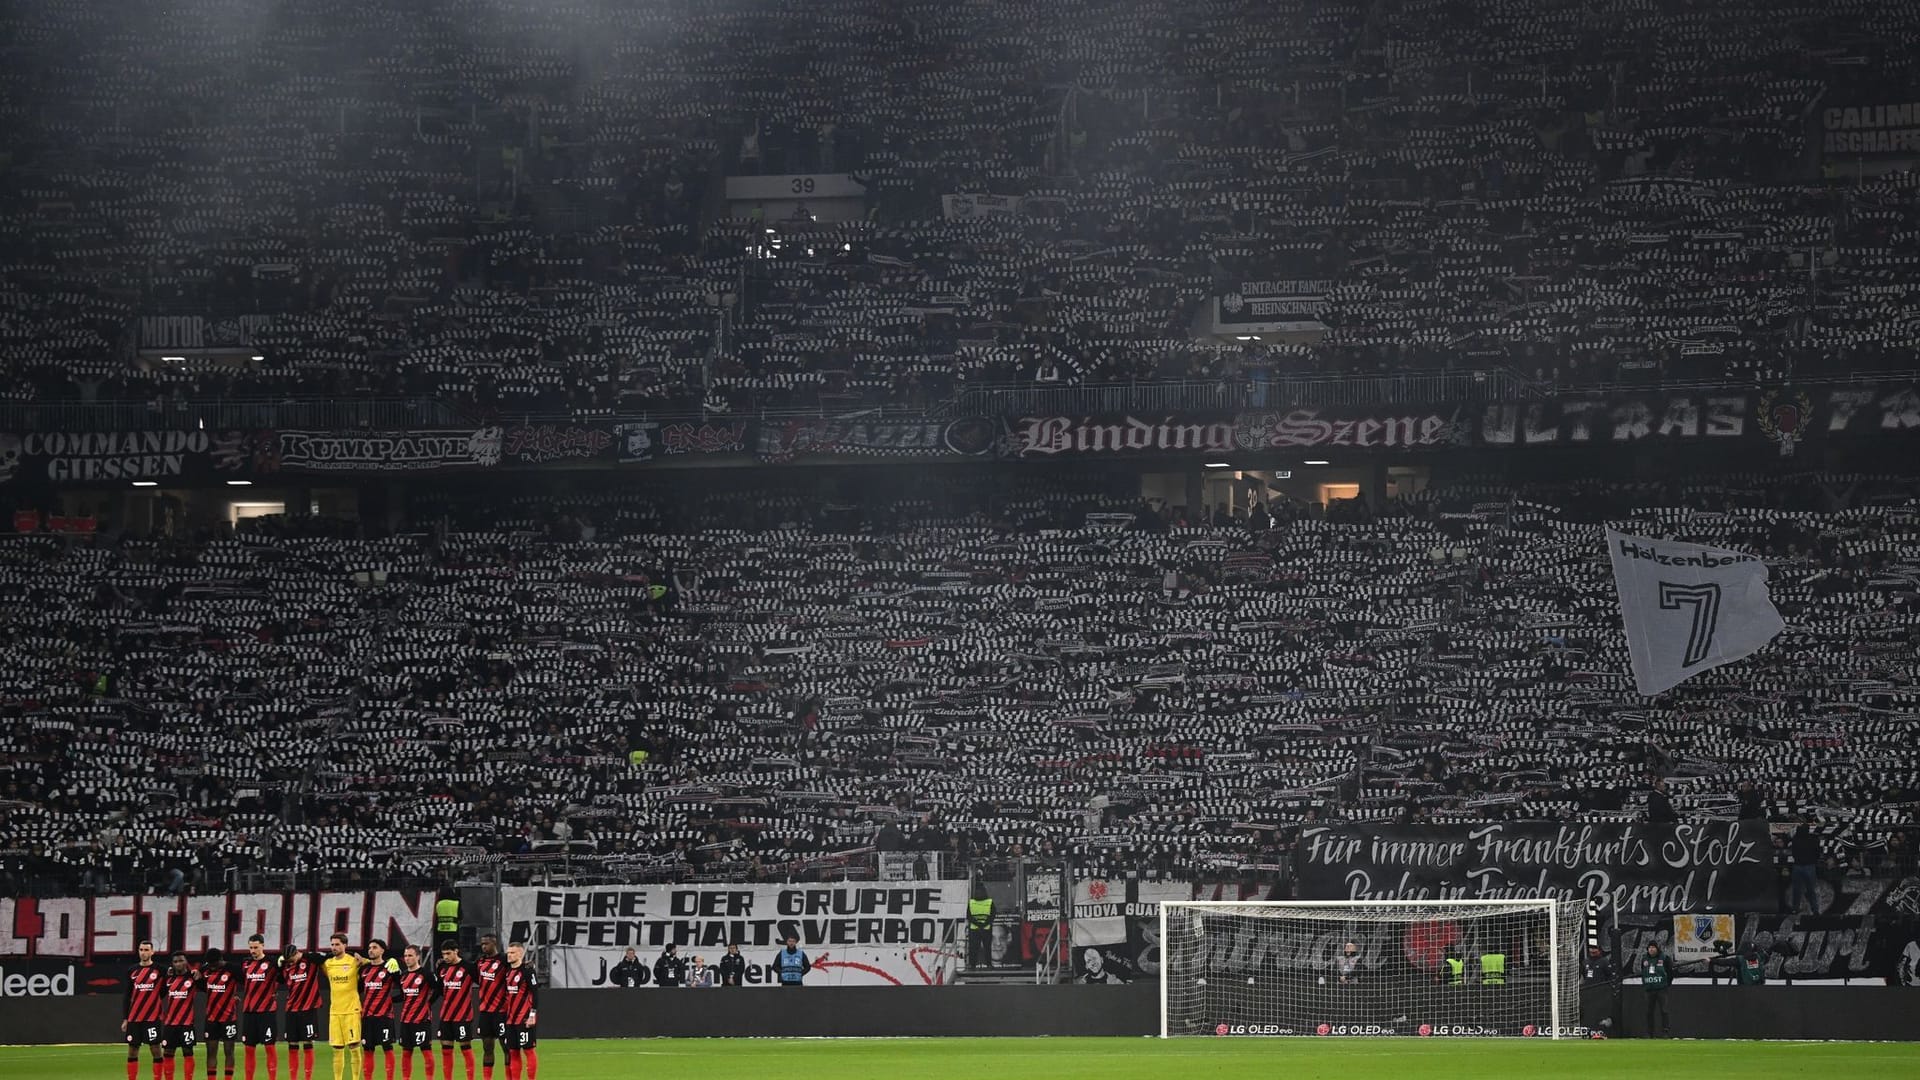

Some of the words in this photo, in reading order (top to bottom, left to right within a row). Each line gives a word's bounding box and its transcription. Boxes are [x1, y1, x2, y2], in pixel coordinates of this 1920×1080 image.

[791, 178, 815, 194] 39
[1241, 280, 1297, 296] EINTRACHT
[142, 315, 204, 348] MOTOR
[1482, 398, 1744, 443] ULTRAS
[1019, 415, 1235, 457] Binding
[1271, 409, 1446, 449] Szene
[24, 430, 209, 456] COMMANDO
[279, 434, 473, 461] KUMPANE
[47, 454, 185, 481] GIESSEN
[1659, 581, 1721, 668] 7
[1303, 827, 1361, 865] Für
[1371, 835, 1464, 867] immer
[1469, 824, 1649, 869] Frankfurts
[1662, 821, 1760, 868] Stolz
[1577, 870, 1696, 914] Bernd
[536, 890, 647, 917] EHRE
[670, 890, 755, 917] DER
[777, 888, 942, 915] GRUPPE
[1074, 904, 1118, 918] NUOVA
[510, 917, 967, 946] AUFENTHALTSVERBOT
[0, 965, 75, 997] eed
[147, 1027, 158, 1039] 15
[183, 1030, 195, 1042] 24
[225, 1025, 237, 1036] 26
[265, 1026, 272, 1038] 4
[306, 1024, 314, 1036] 11
[382, 1028, 389, 1039] 7
[415, 1031, 426, 1042] 27
[459, 1026, 466, 1037] 8
[519, 1031, 529, 1043] 31
[1230, 1024, 1245, 1034] LG
[1248, 1024, 1279, 1034] OLED
[1332, 1024, 1347, 1035] LG
[1350, 1024, 1381, 1034] OLED
[1433, 1025, 1448, 1035] LG
[1452, 1025, 1483, 1035] OLED
